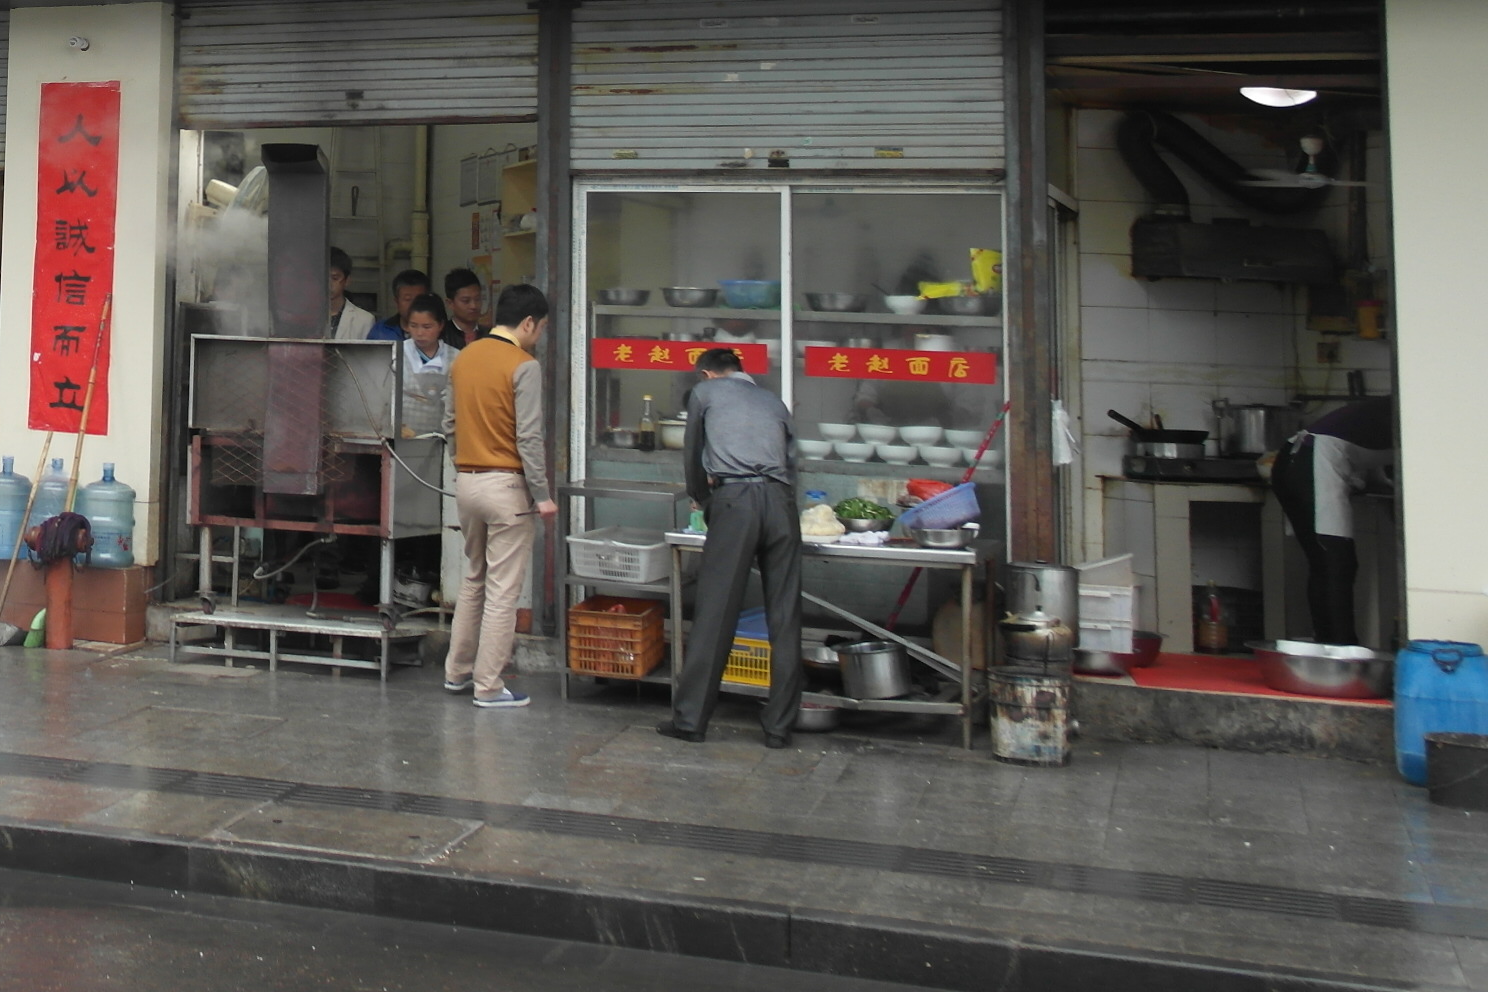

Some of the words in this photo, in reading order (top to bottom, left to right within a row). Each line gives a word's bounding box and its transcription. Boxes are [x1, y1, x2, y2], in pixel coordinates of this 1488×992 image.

[612, 344, 744, 365] 老赵面
[827, 352, 971, 379] 老赵面店
